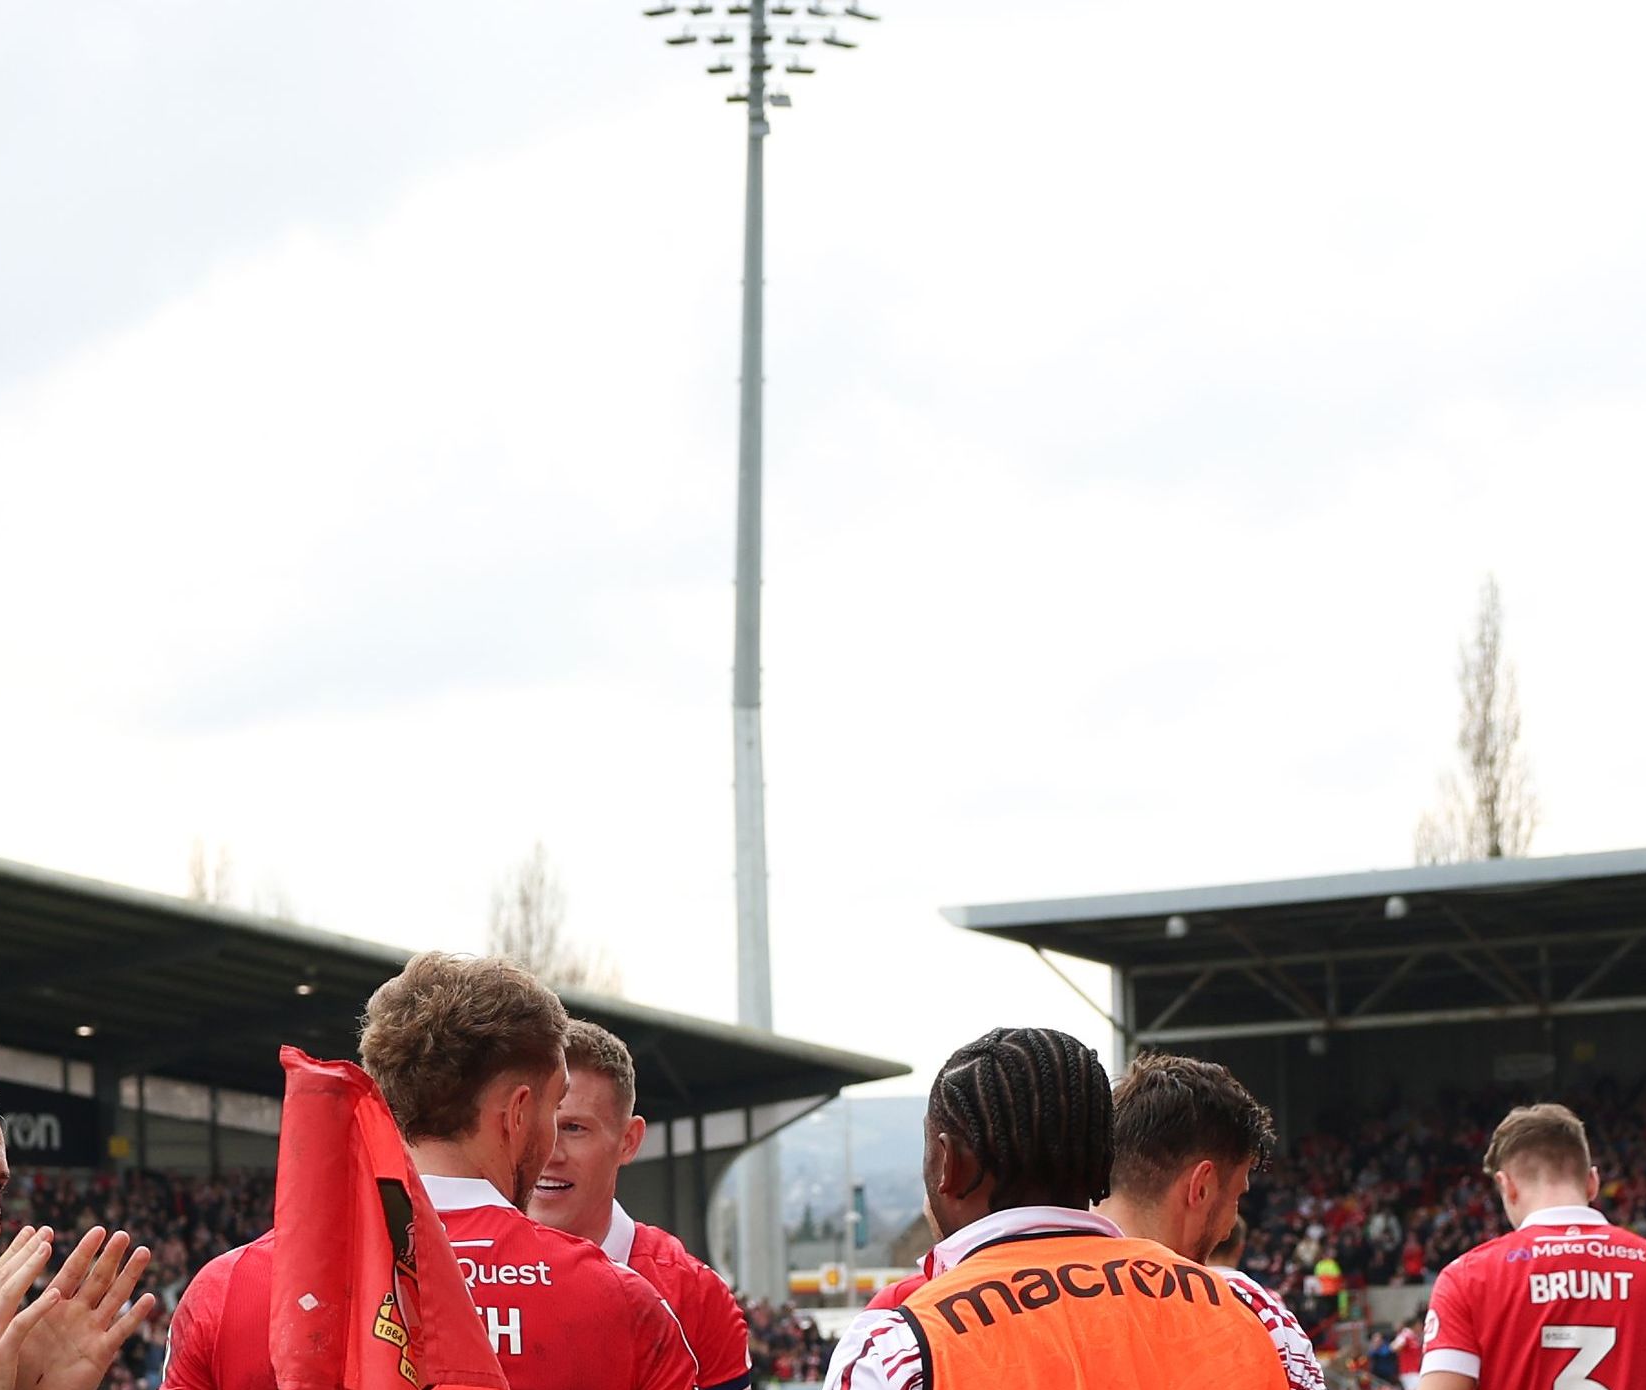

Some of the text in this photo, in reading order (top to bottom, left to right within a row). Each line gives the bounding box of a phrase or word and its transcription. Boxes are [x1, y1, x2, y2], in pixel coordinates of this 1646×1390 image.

[1532, 1241, 1646, 1262] Meta Quest
[457, 1258, 552, 1288] Quest
[1530, 1270, 1634, 1304] BRUNT
[934, 1258, 1220, 1334] macron
[379, 1324, 403, 1343] 1864
